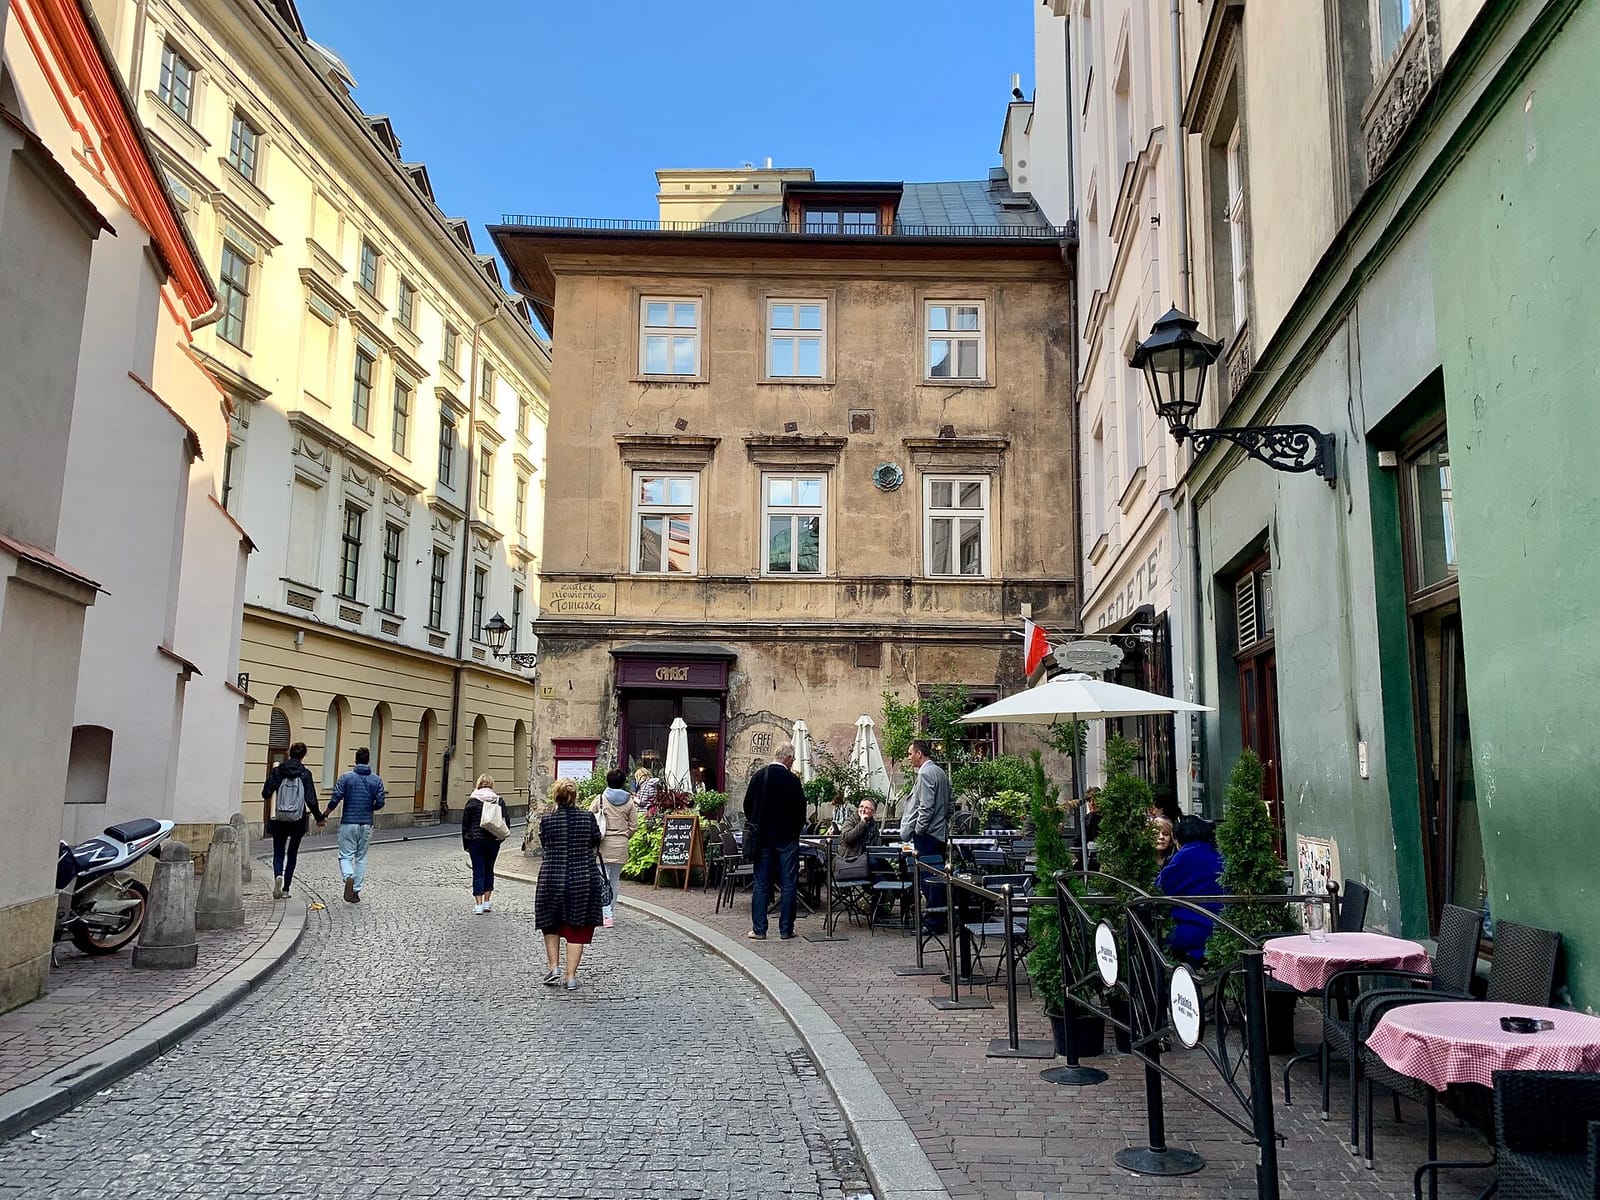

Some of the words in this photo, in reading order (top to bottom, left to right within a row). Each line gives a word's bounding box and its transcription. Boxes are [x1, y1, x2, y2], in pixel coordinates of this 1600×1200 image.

[549, 599, 602, 613] Tomasza
[655, 666, 690, 681] CAMELOT
[543, 687, 553, 695] 17
[752, 733, 771, 746] CAFE
